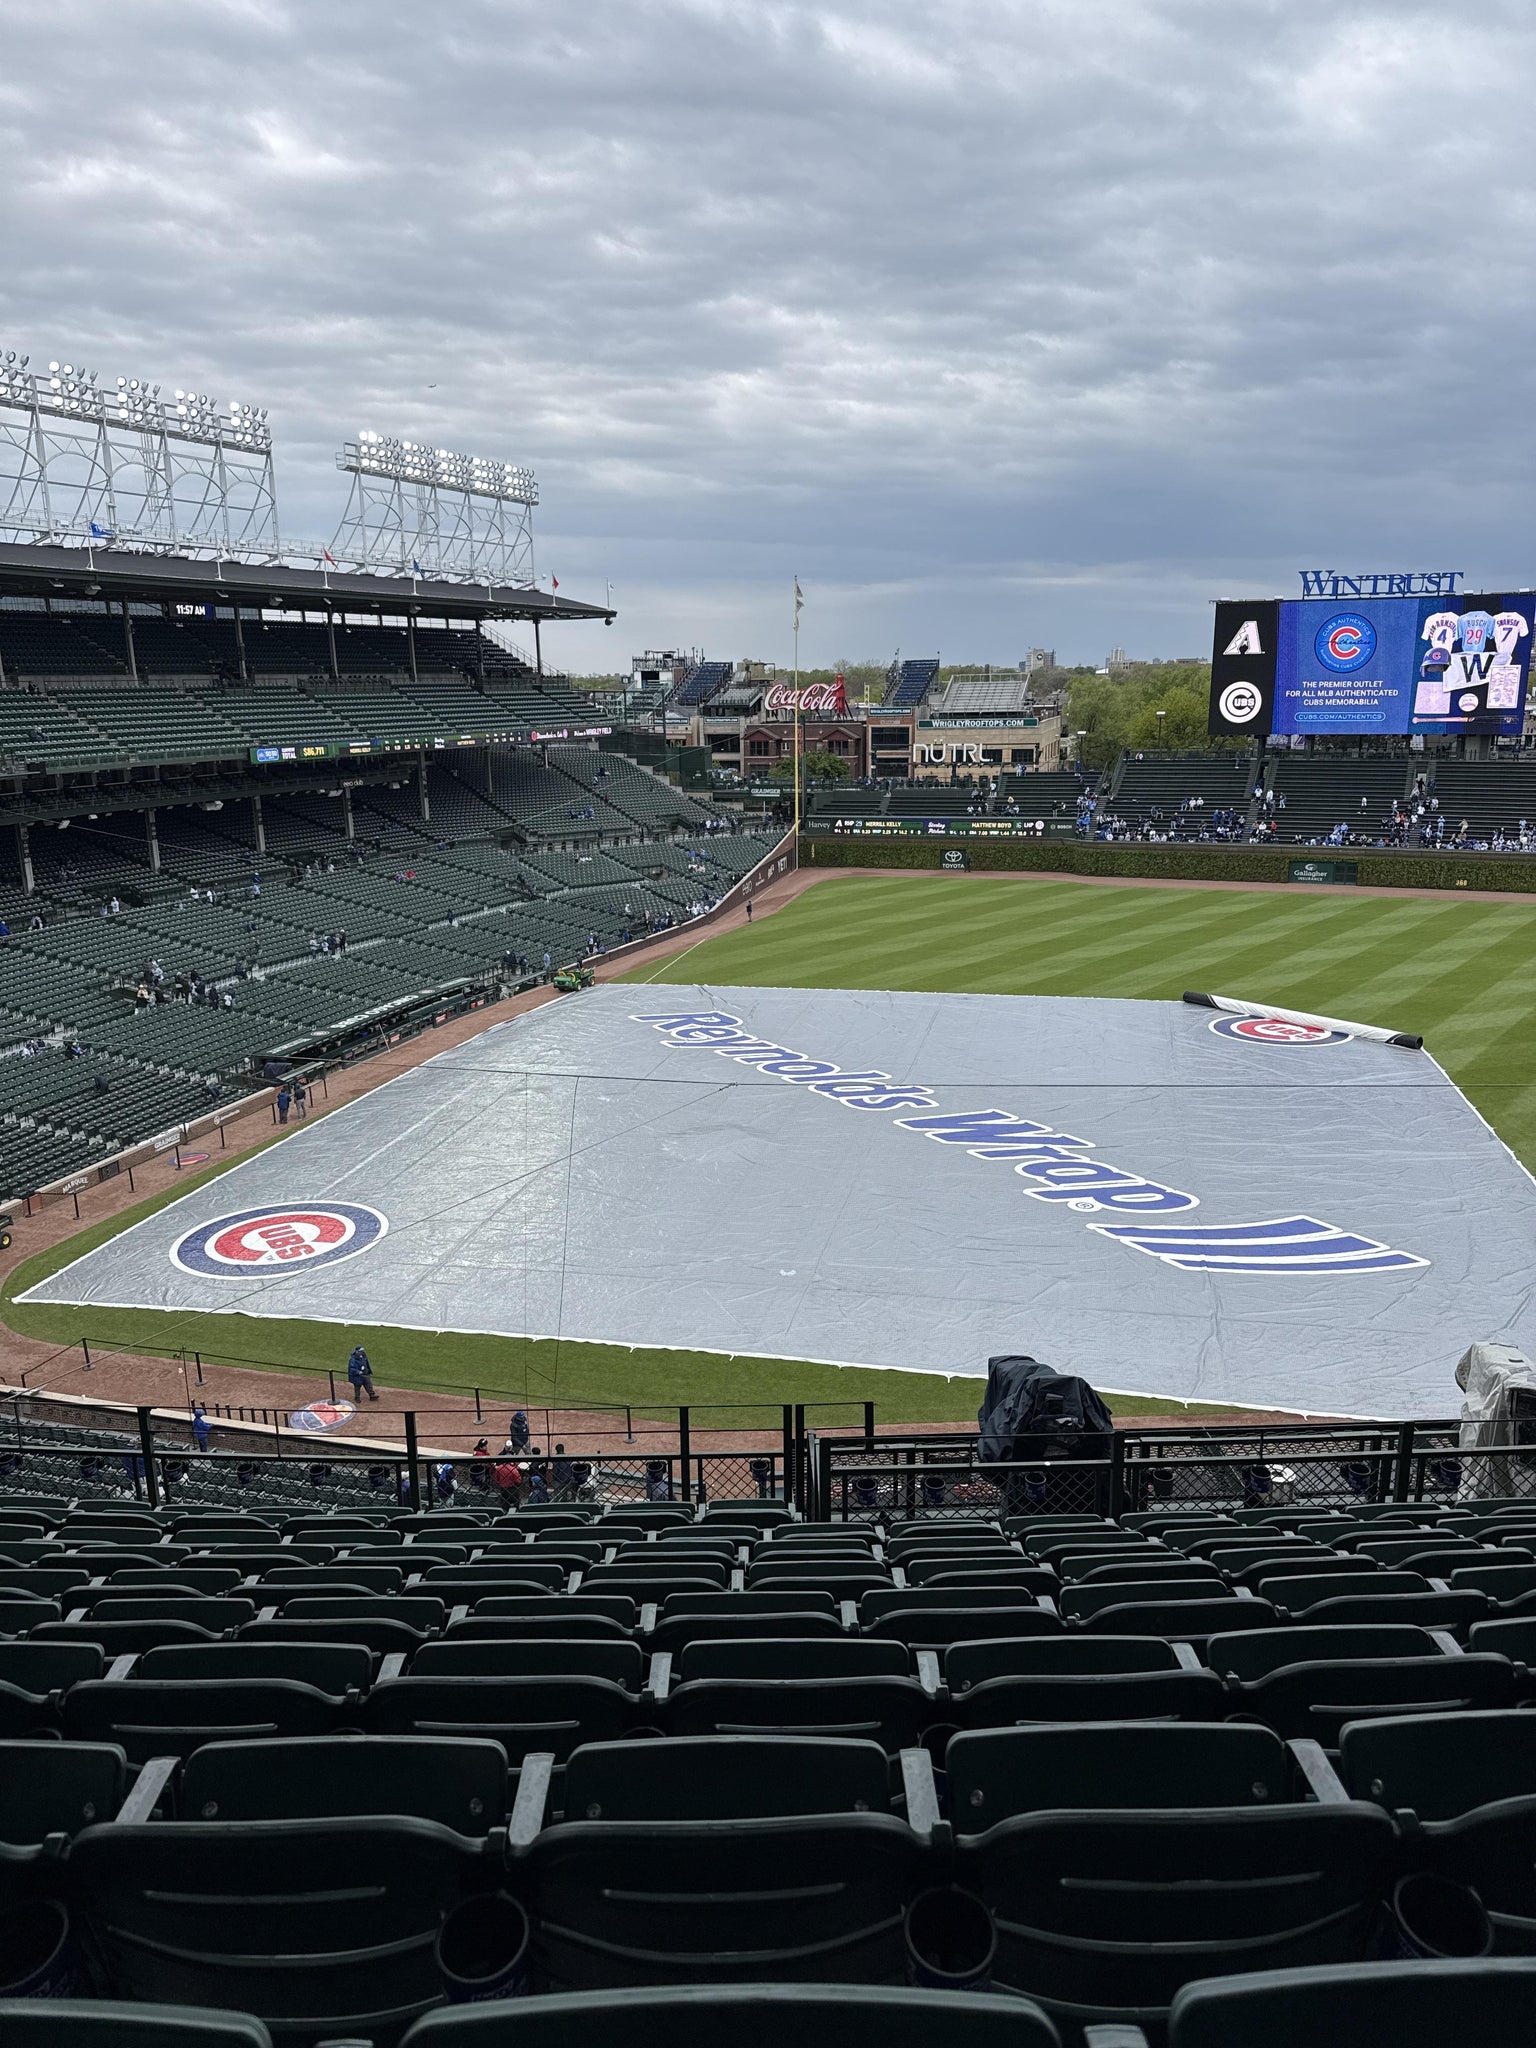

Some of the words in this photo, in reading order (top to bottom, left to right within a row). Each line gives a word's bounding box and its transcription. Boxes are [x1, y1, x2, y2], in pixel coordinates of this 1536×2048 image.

[1299, 570, 1464, 597] WINTRUST
[176, 605, 193, 615] 11:57
[195, 606, 205, 615] AM
[1323, 622, 1336, 636] CUBS
[1337, 618, 1371, 635] AUTHENTICS
[1502, 627, 1513, 642] 7
[1437, 629, 1447, 643] 4
[1467, 629, 1483, 645] 29
[1460, 653, 1495, 683] W
[932, 719, 1024, 728] WRIGLEYROOFTOPS.COM
[808, 821, 831, 829] Harvey
[778, 856, 788, 872] YETI
[1293, 869, 1328, 878] Gallagher
[628, 1010, 939, 1110] Reynolds
[154, 1133, 181, 1149] GRAINGER
[62, 1176, 88, 1193] MARQUEE
